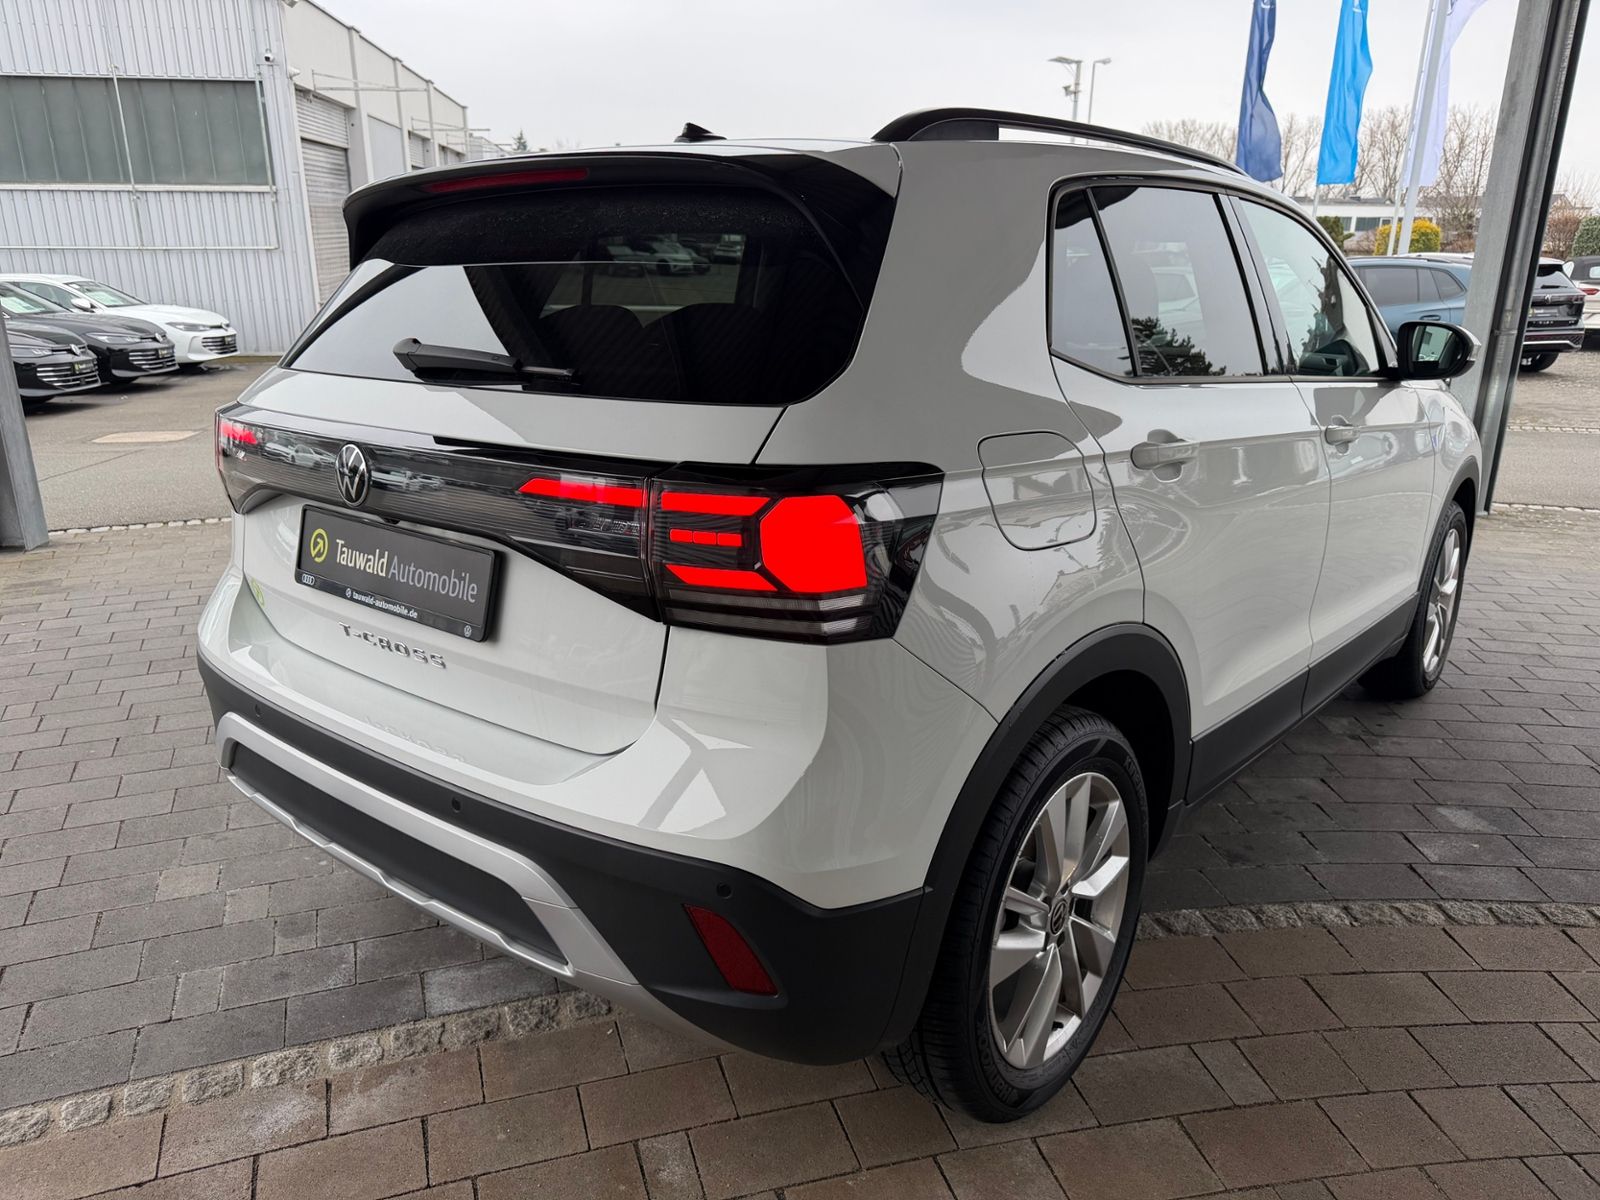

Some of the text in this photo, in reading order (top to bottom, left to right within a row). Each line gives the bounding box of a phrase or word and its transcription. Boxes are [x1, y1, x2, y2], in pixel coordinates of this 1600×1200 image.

[336, 538, 478, 603] Tauwald Automobile
[353, 591, 418, 618] tauwald-automobile.de
[339, 621, 447, 669] T-CROSS
